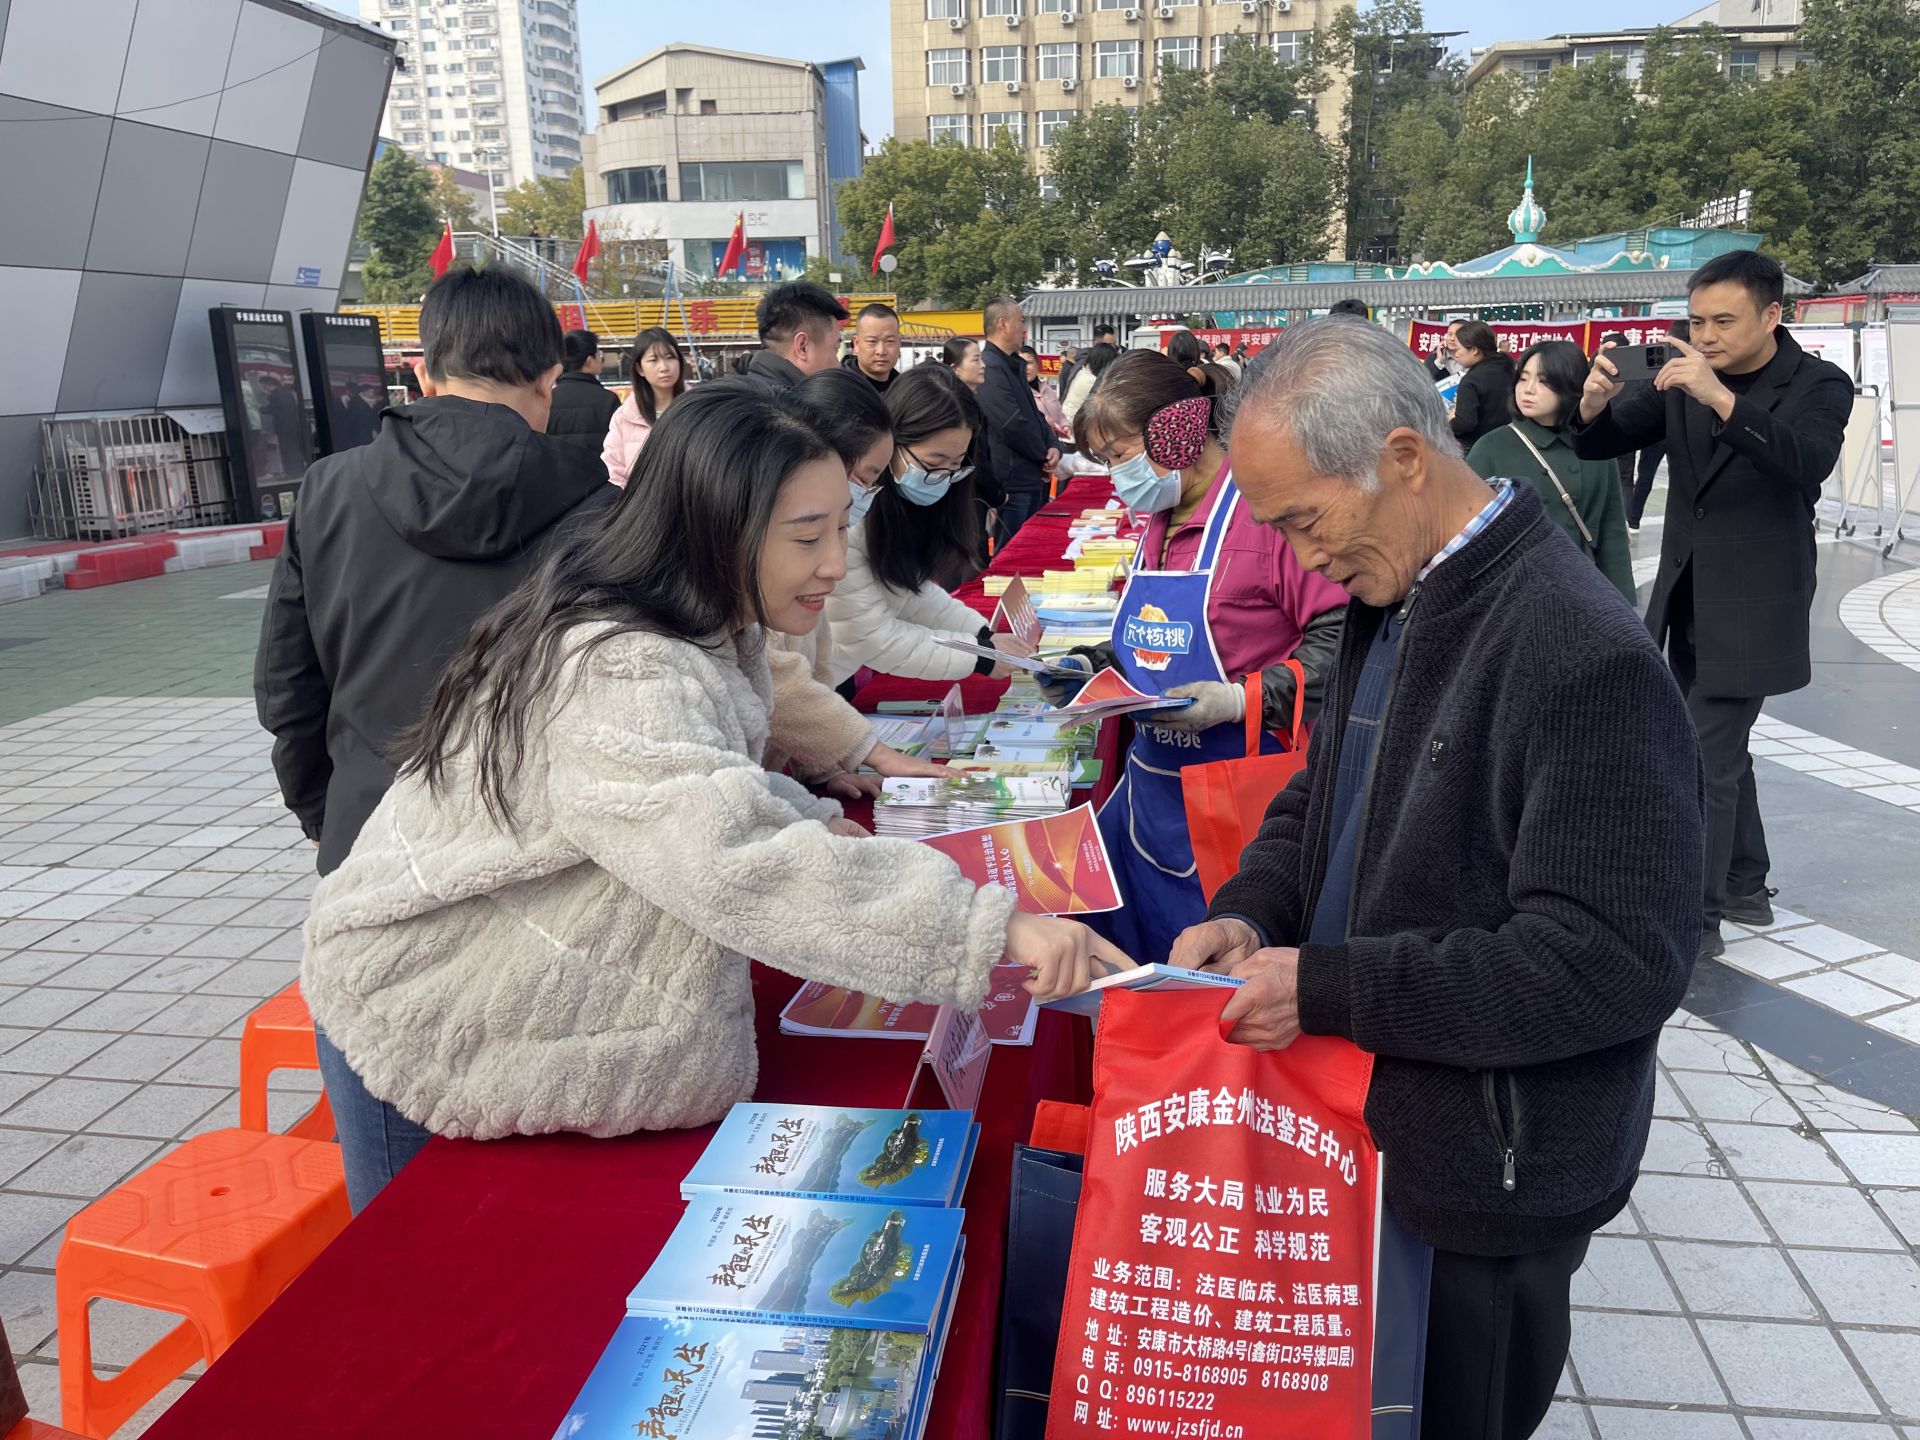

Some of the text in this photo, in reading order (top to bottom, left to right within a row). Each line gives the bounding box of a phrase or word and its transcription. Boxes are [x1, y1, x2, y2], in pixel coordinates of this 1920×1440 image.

[1127, 623, 1185, 648] 六个核桃
[1136, 722, 1202, 749] 核桃
[1144, 1167, 1329, 1218] 服务大局 执业为民
[1139, 1213, 1331, 1262] 客观公正 科学规范
[1261, 1370, 1329, 1393] 8168908
